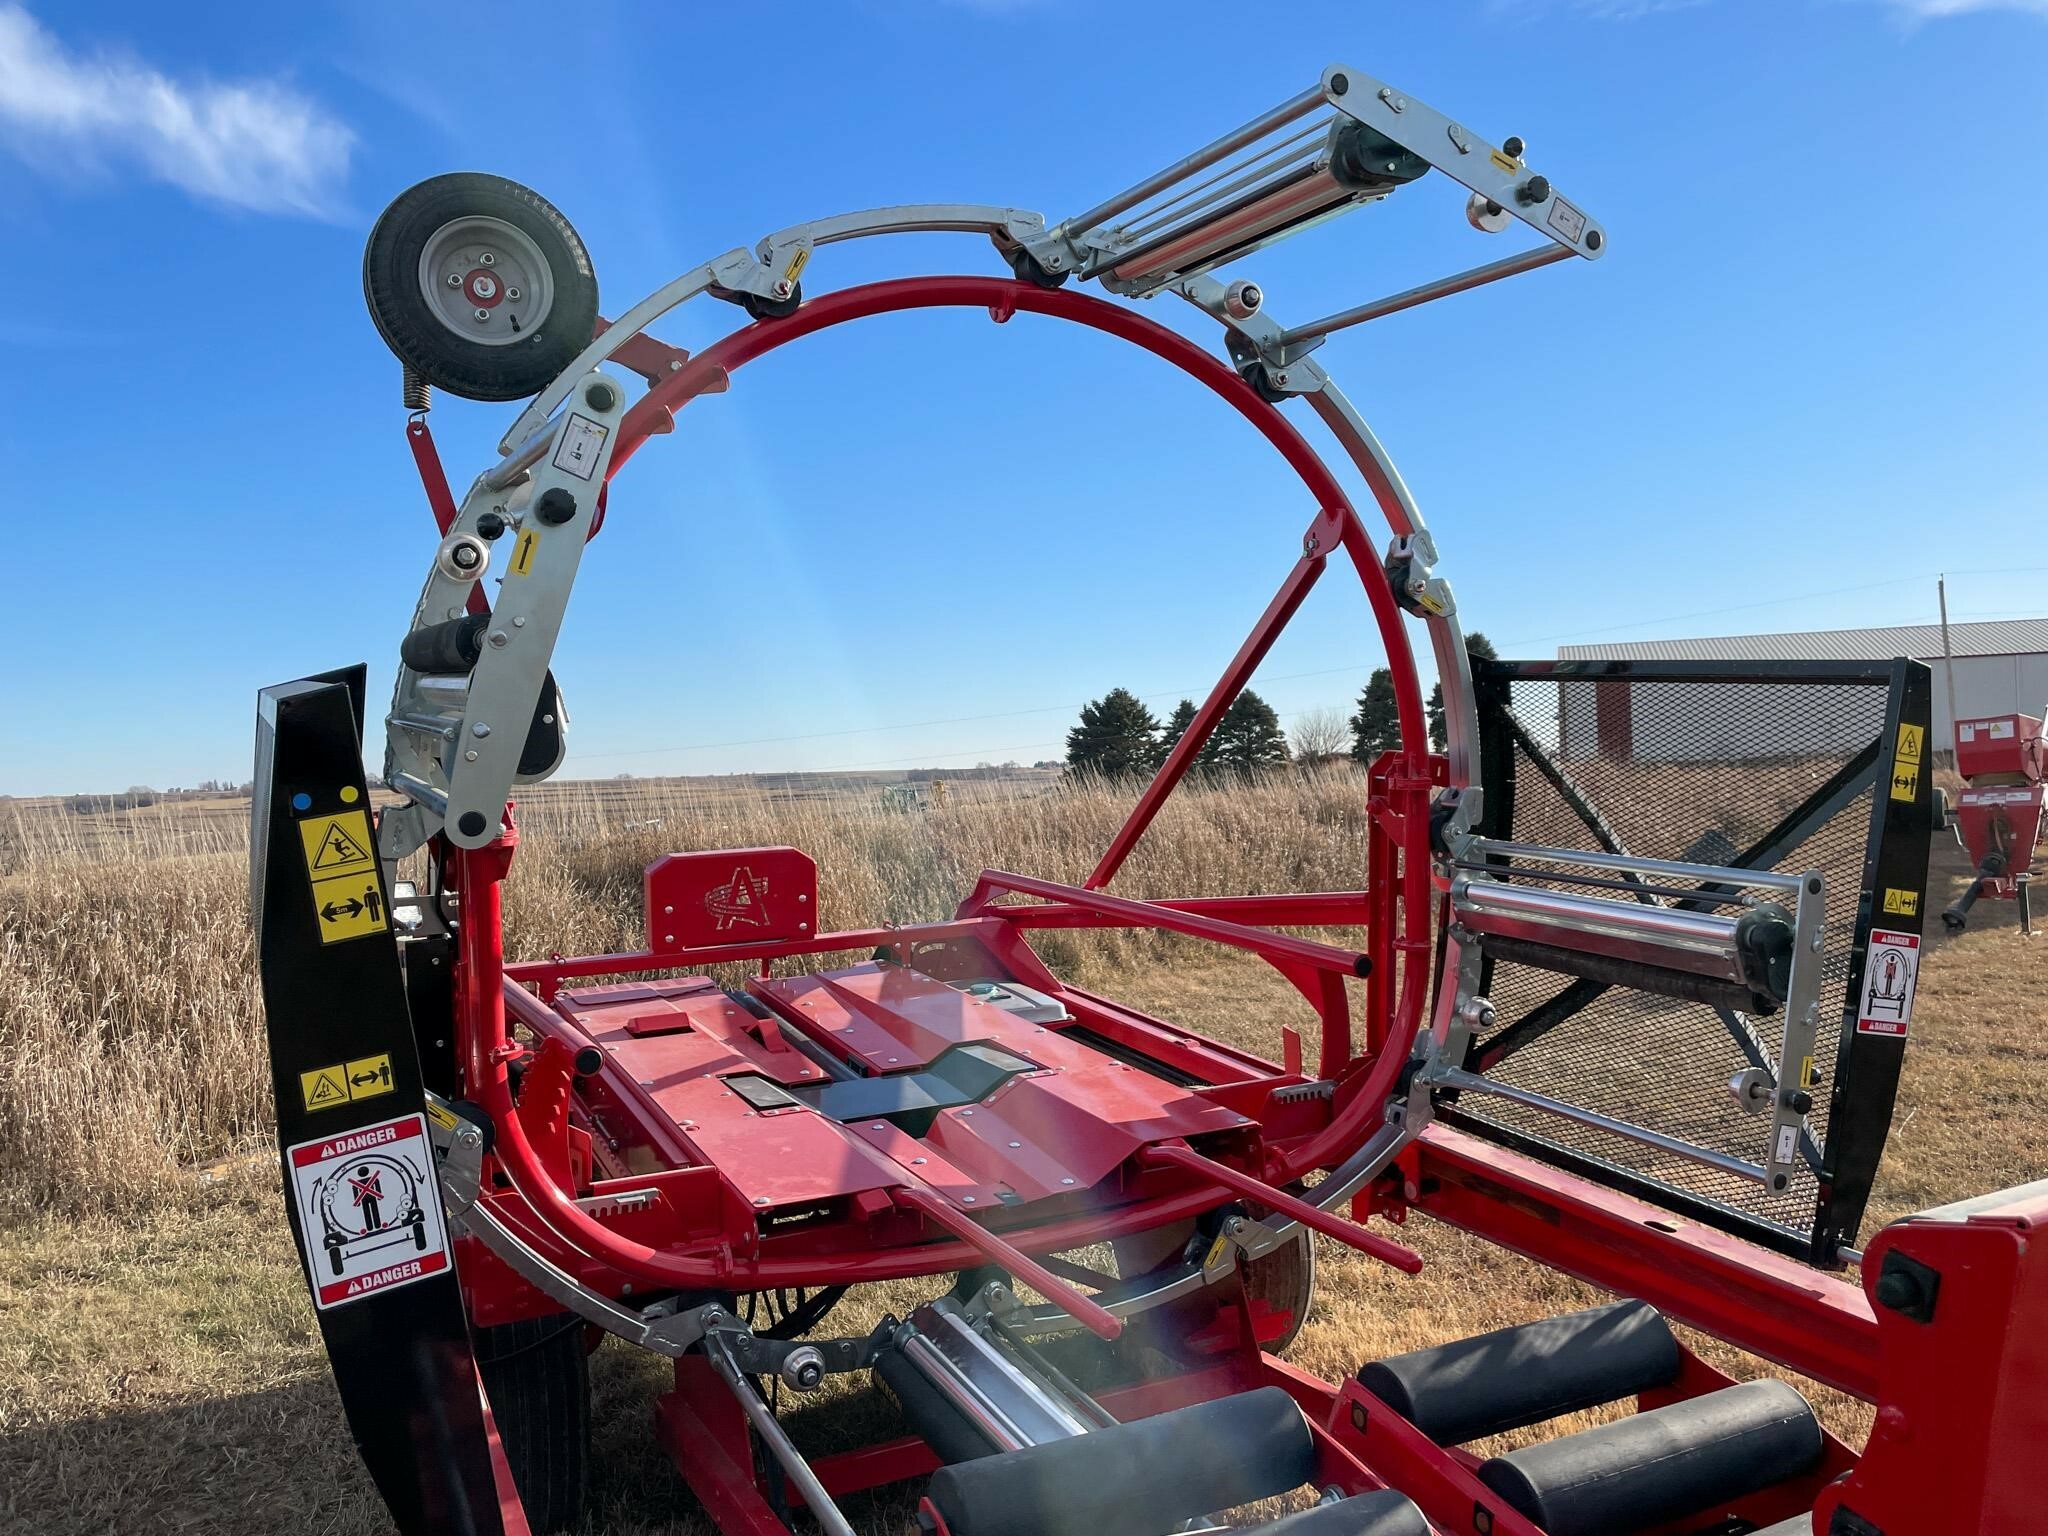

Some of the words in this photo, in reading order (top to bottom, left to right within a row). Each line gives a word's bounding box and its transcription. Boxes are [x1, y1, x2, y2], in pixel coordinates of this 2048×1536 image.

[1886, 935, 1909, 946] DANGER
[1874, 1021, 1897, 1032] DANGER
[335, 1127, 397, 1154] DANGER
[361, 1261, 422, 1289] DANGER
